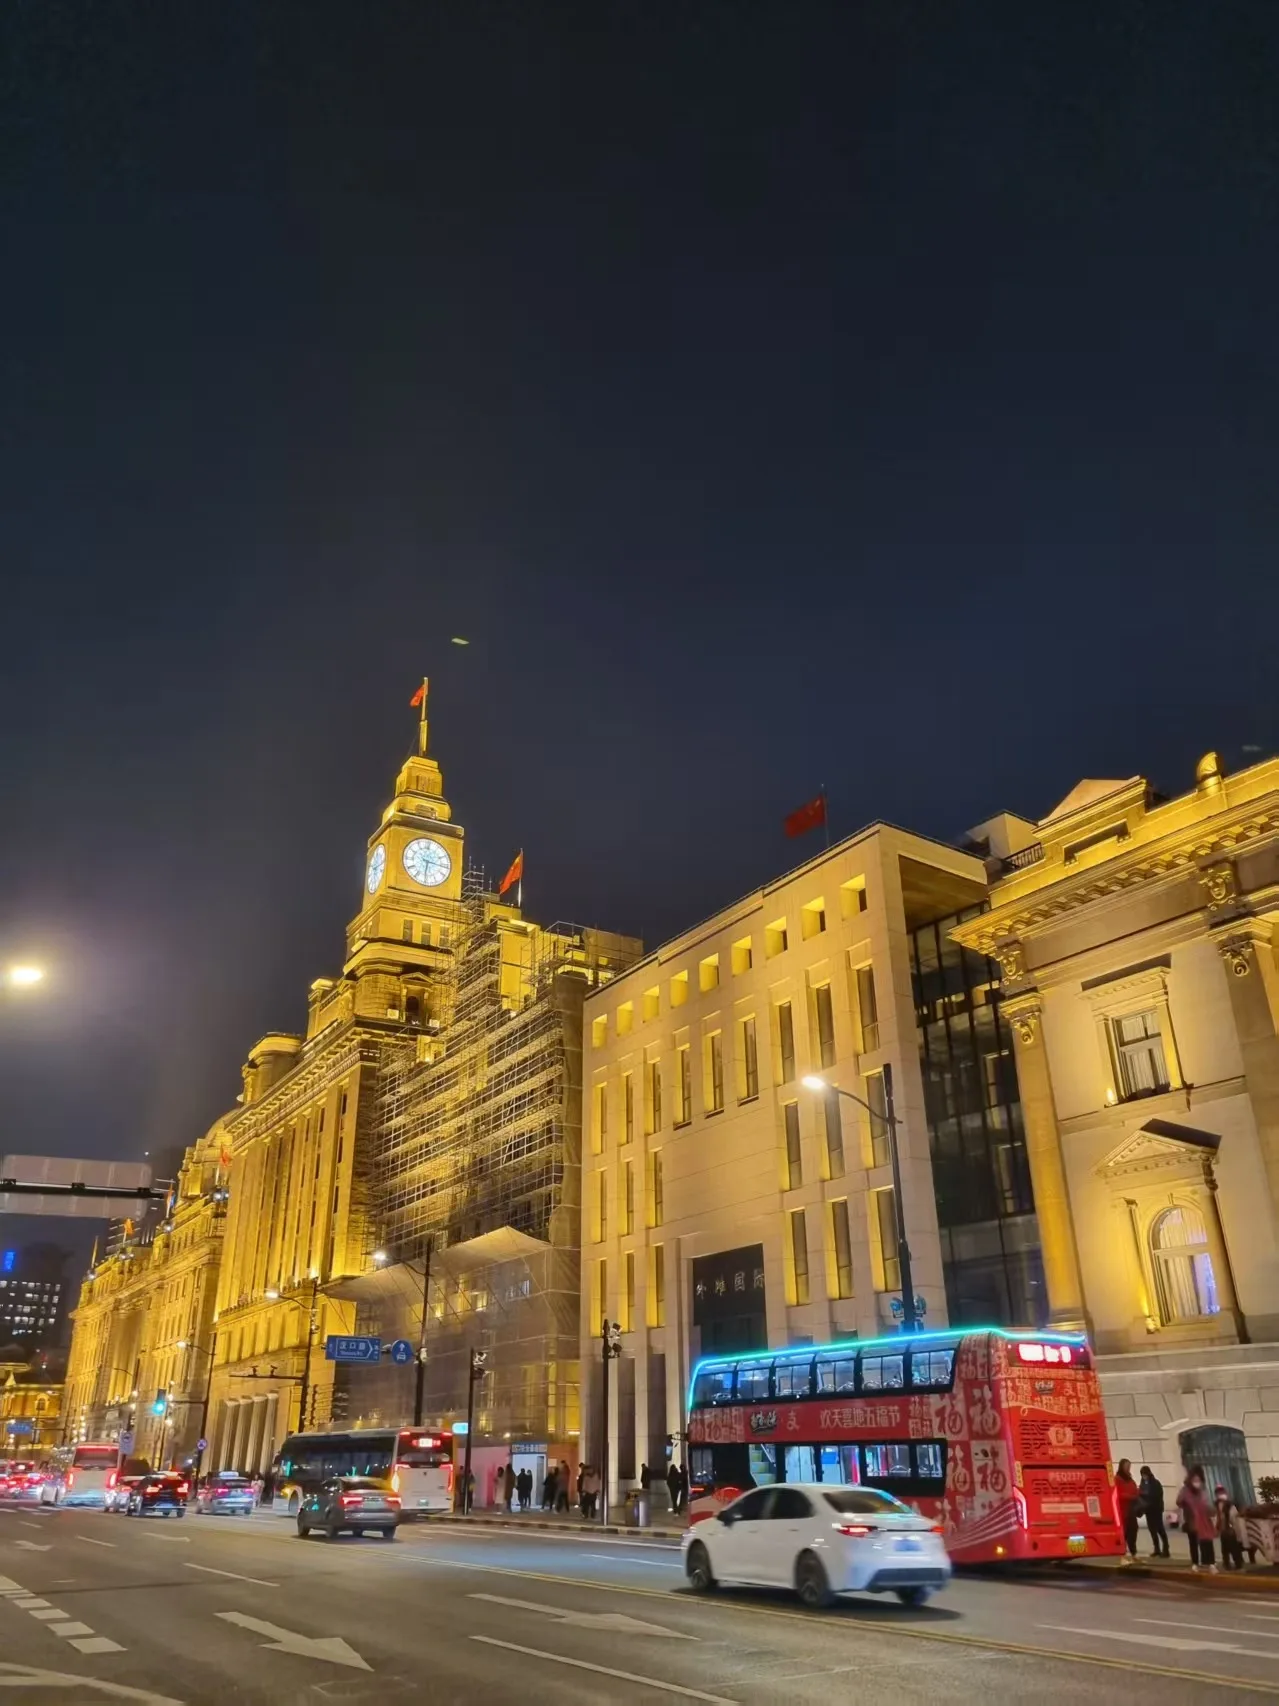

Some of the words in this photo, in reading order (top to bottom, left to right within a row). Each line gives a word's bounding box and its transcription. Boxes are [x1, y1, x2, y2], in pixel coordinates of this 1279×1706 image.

[819, 1405, 901, 1429] 欢天喜地五福节
